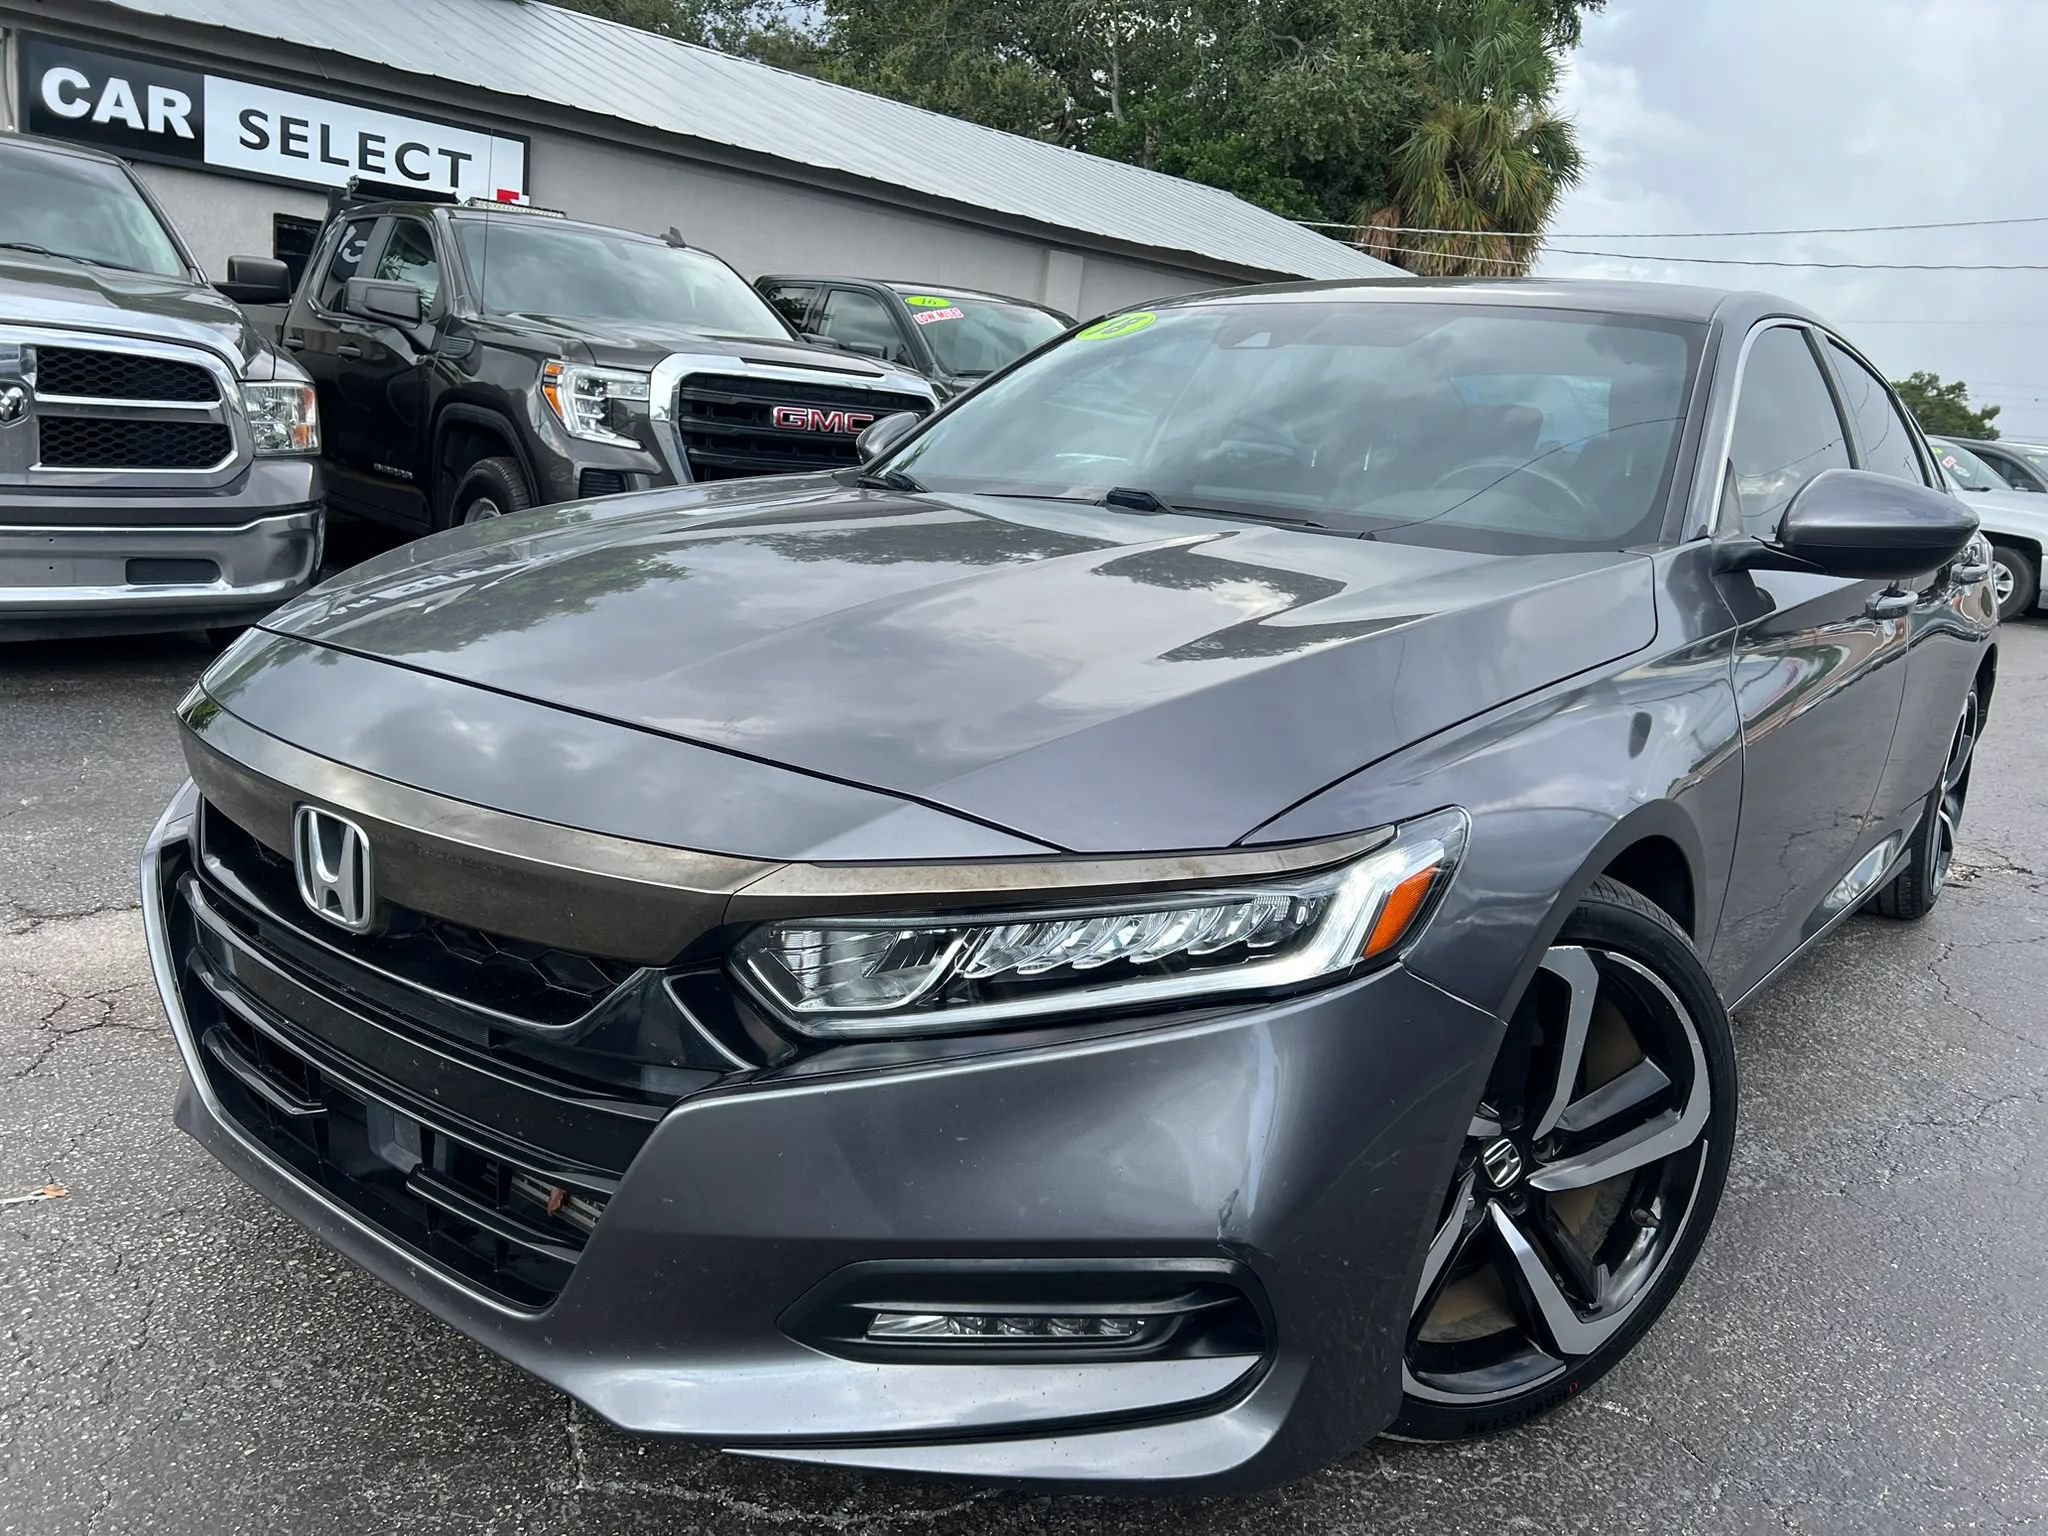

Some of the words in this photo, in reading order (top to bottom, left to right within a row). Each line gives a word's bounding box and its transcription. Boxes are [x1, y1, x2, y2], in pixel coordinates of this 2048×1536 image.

[41, 67, 195, 139] CAR
[239, 109, 472, 188] SELECT
[915, 312, 936, 323] LOW
[773, 406, 874, 435] GMC
